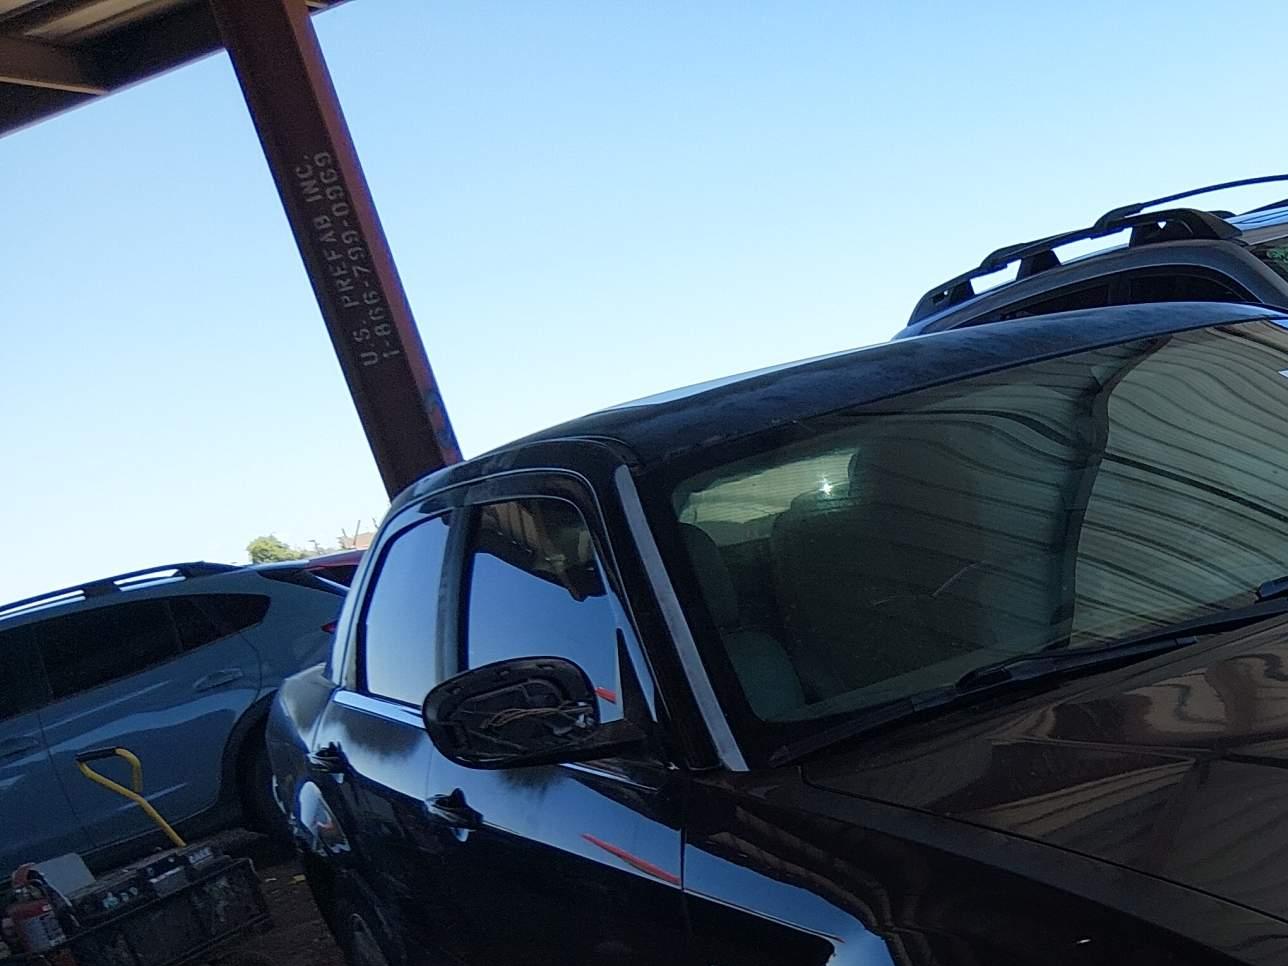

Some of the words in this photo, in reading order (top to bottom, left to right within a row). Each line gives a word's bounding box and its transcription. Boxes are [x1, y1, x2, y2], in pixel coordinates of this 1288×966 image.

[295, 154, 323, 203] INC.
[314, 215, 361, 309] PREFAB
[353, 319, 379, 367] U.S.
